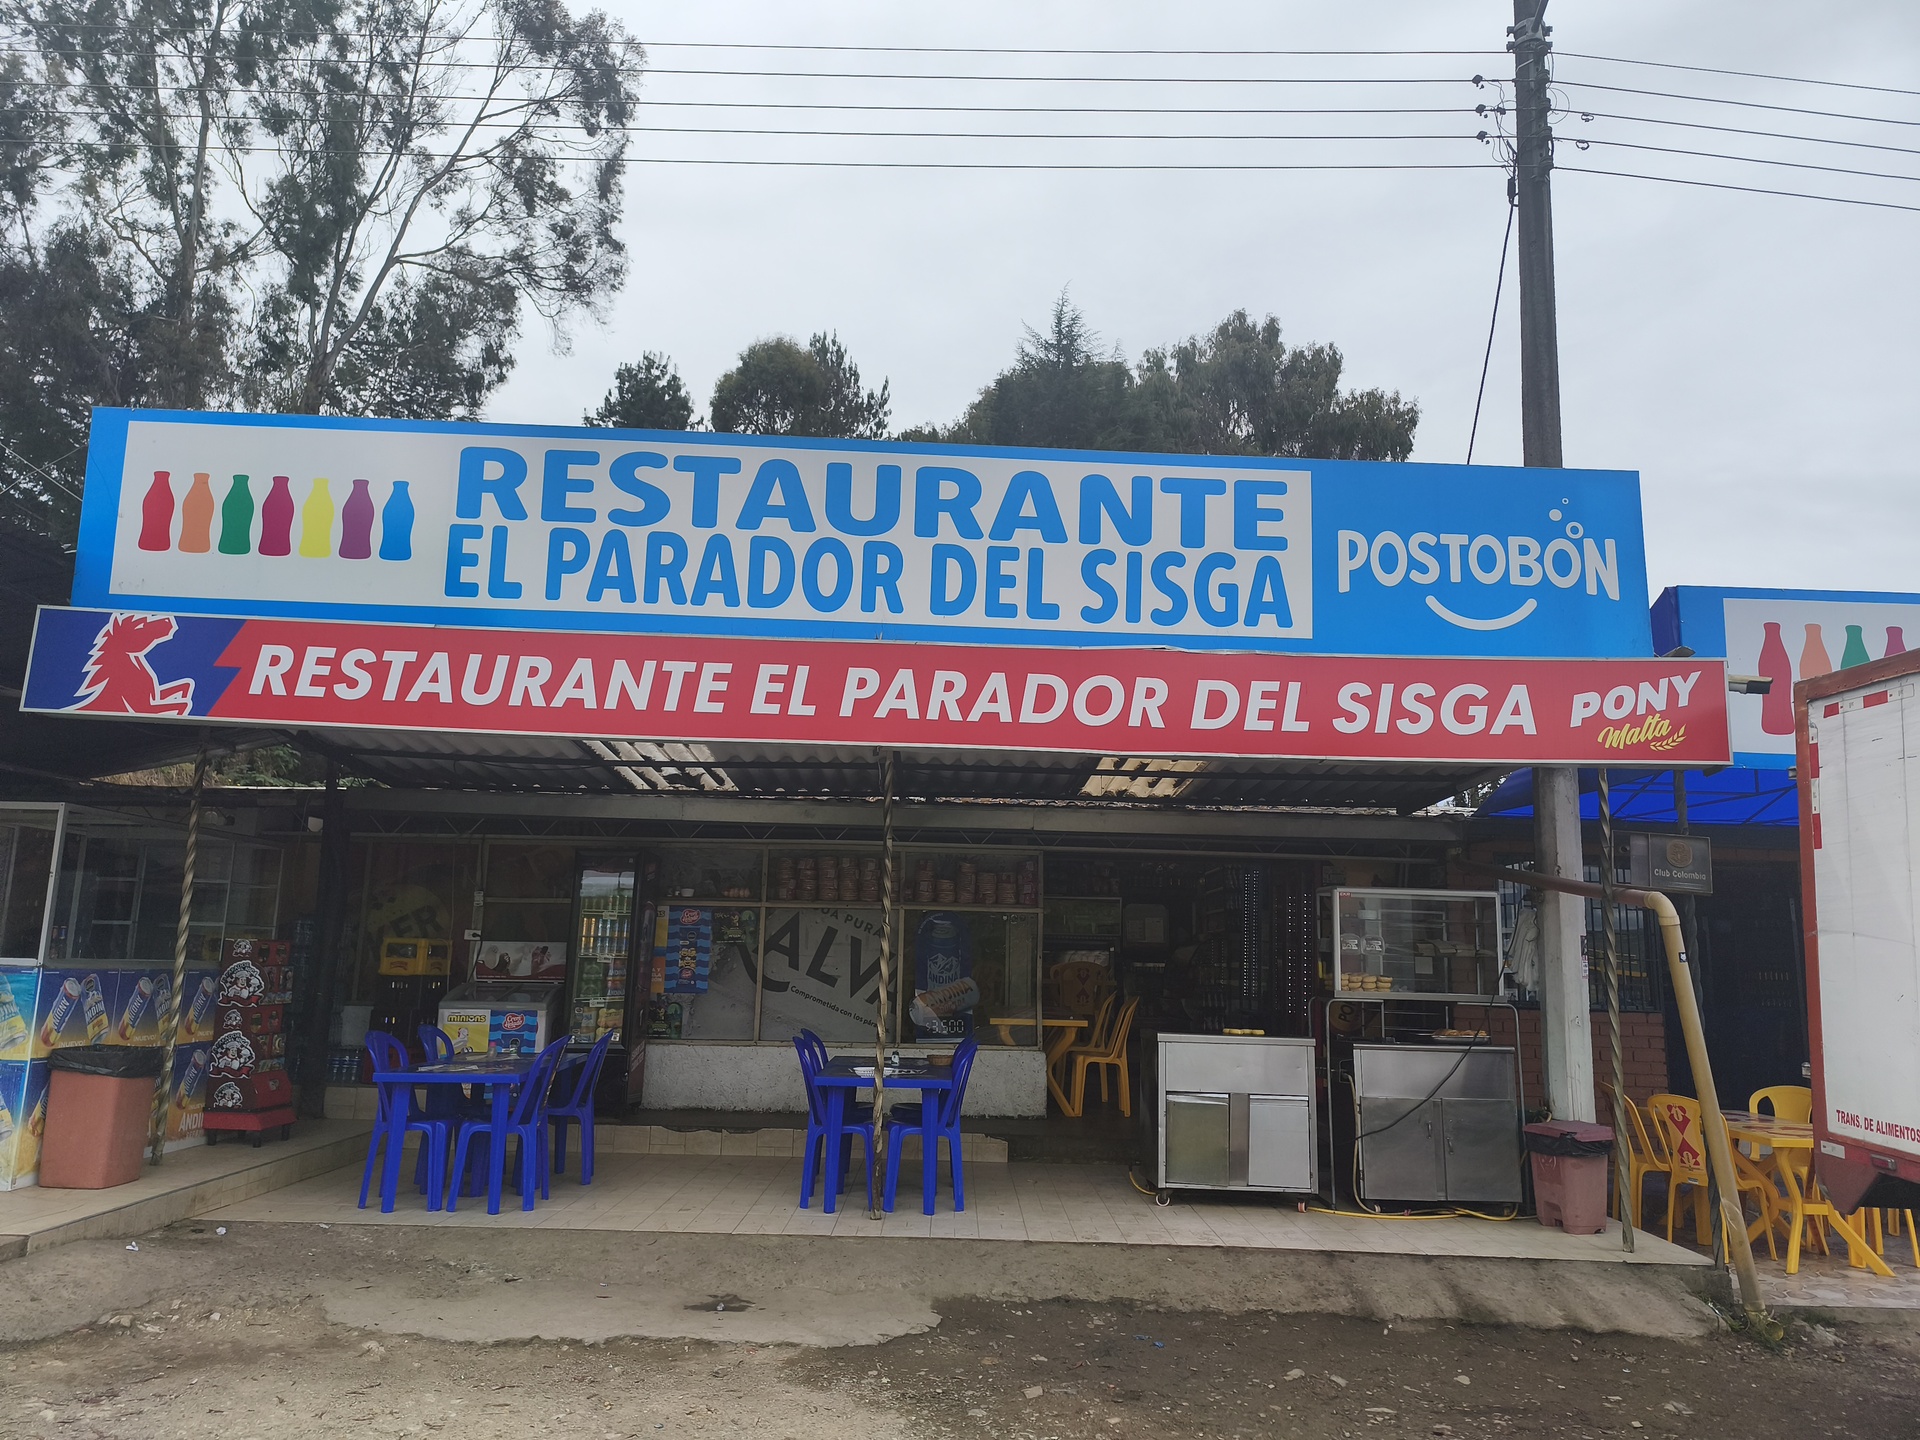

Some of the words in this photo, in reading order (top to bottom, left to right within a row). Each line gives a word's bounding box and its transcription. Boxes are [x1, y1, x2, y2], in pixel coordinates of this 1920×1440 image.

[455, 447, 1289, 552] RESTAURANTE
[444, 524, 523, 600] EL
[546, 528, 905, 615] PARADOR
[930, 544, 1061, 621] DEL
[1080, 549, 1294, 629] SISGA
[249, 645, 733, 713] RESTAURANTE
[751, 664, 817, 716] EL
[840, 668, 1169, 729] PARADOR
[1191, 680, 1310, 732] DEL
[1333, 682, 1537, 736] SISGA
[1570, 671, 1702, 728] PONY
[1597, 713, 1672, 750] Malta
[1654, 868, 1671, 877] Club
[1672, 871, 1707, 880] Colombia
[928, 970, 959, 985] ANDINA
[51, 996, 70, 1030] ANDINA
[127, 994, 144, 1025] ANDINA
[790, 985, 839, 1012] Comprometida
[840, 1008, 853, 1018] con
[853, 1012, 863, 1022] los
[926, 1019, 964, 1034] $3.500
[1836, 1109, 1862, 1129] TRANS.
[1864, 1117, 1874, 1132] DE
[1876, 1120, 1920, 1143] ALIMENTOS
